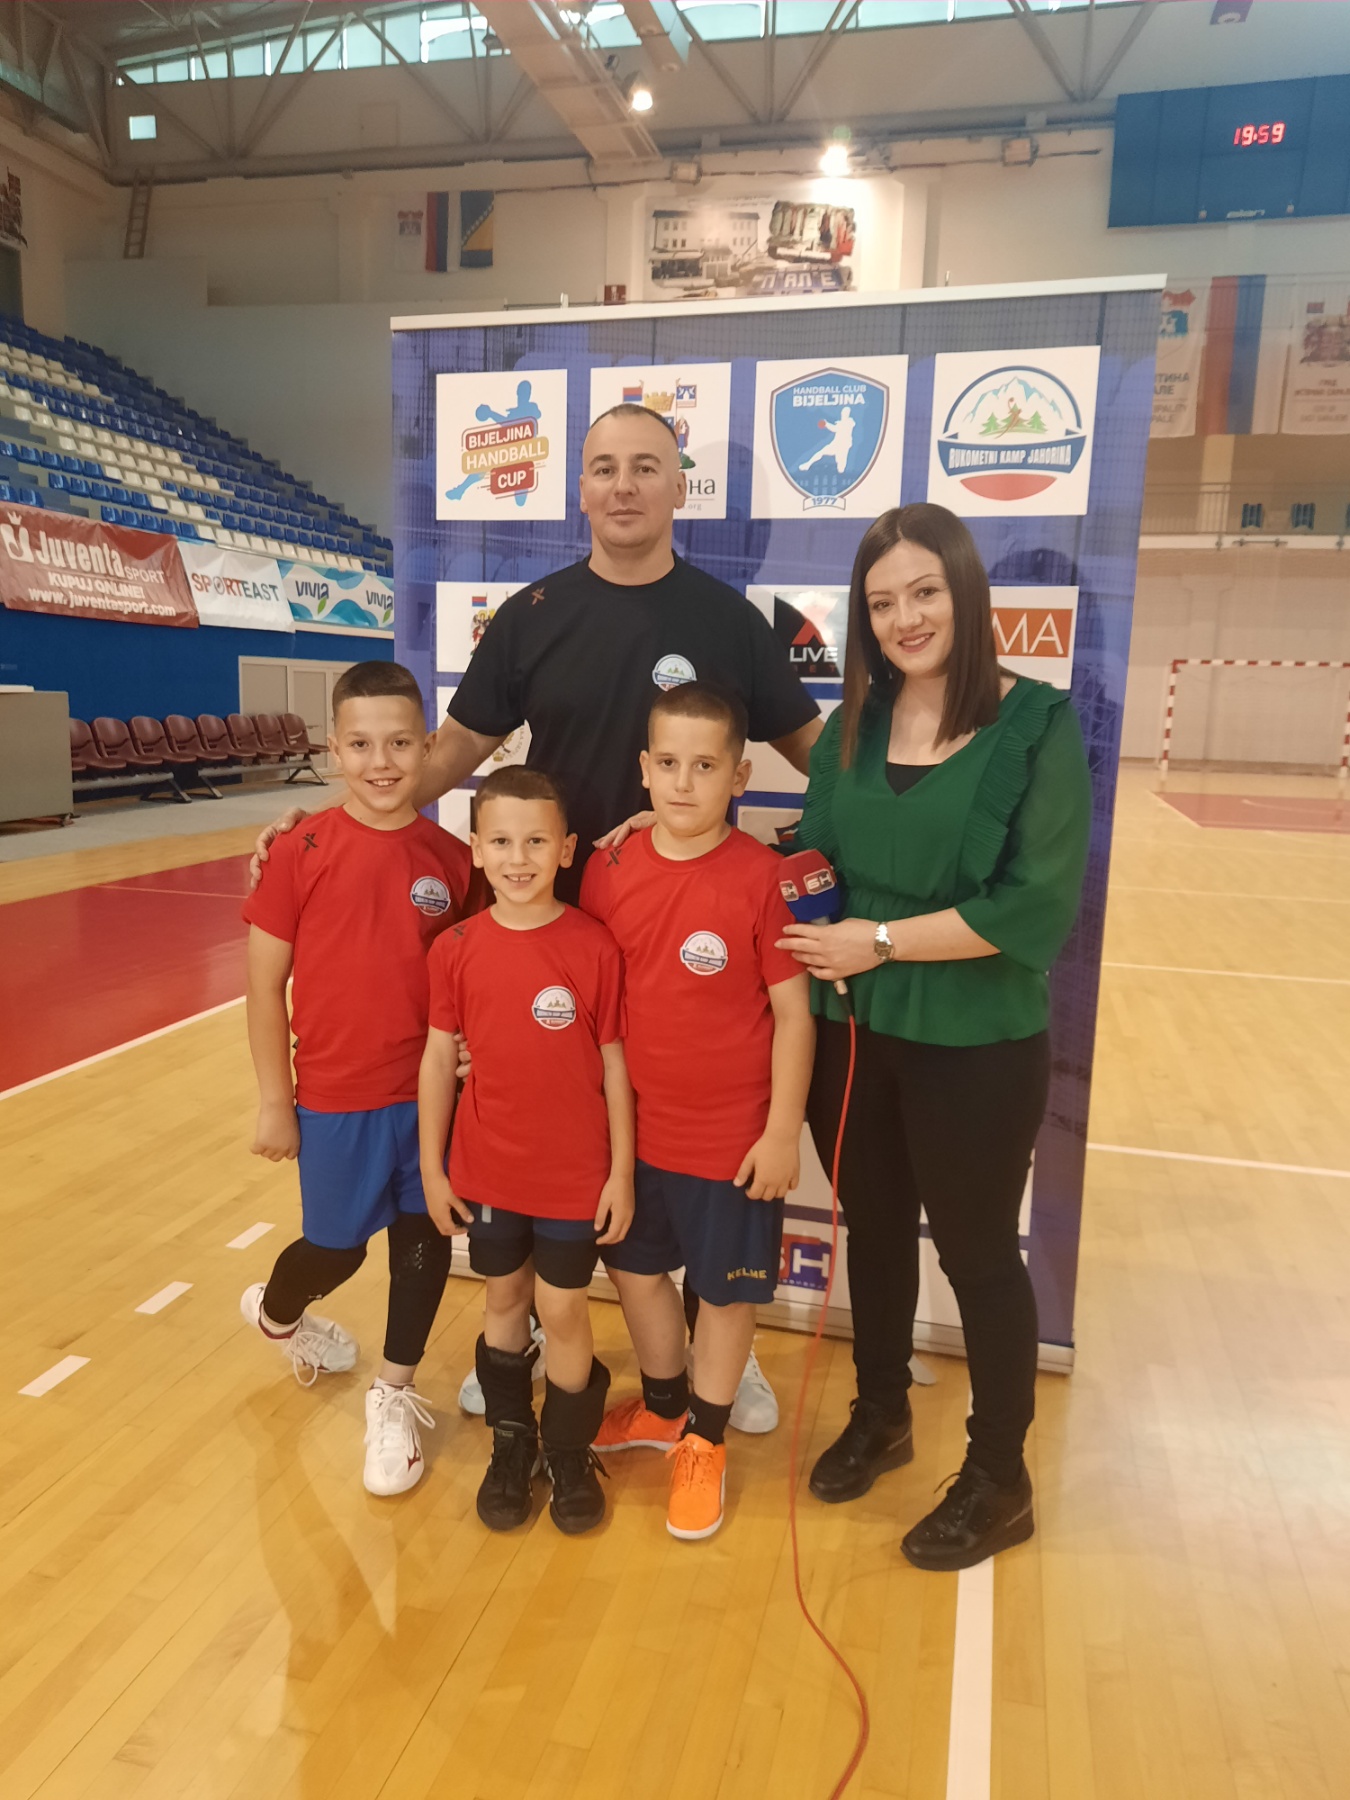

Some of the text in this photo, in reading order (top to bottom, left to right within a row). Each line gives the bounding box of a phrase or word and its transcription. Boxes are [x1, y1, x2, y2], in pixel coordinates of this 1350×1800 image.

[793, 385, 867, 395] HANDBALL CLUB
[792, 393, 866, 407] BIJELJINA
[468, 424, 532, 449] BIJELJINA
[466, 441, 546, 470] HANDBALL
[948, 444, 1072, 469] RUKOMETNI KAMP JAHORINA
[497, 470, 527, 489] CUP
[811, 496, 838, 506] 1977
[36, 531, 166, 584] Juventa SPORT
[48, 572, 94, 592] KUPUJ
[789, 647, 838, 662] LIVE
[727, 1267, 767, 1281] KELME
